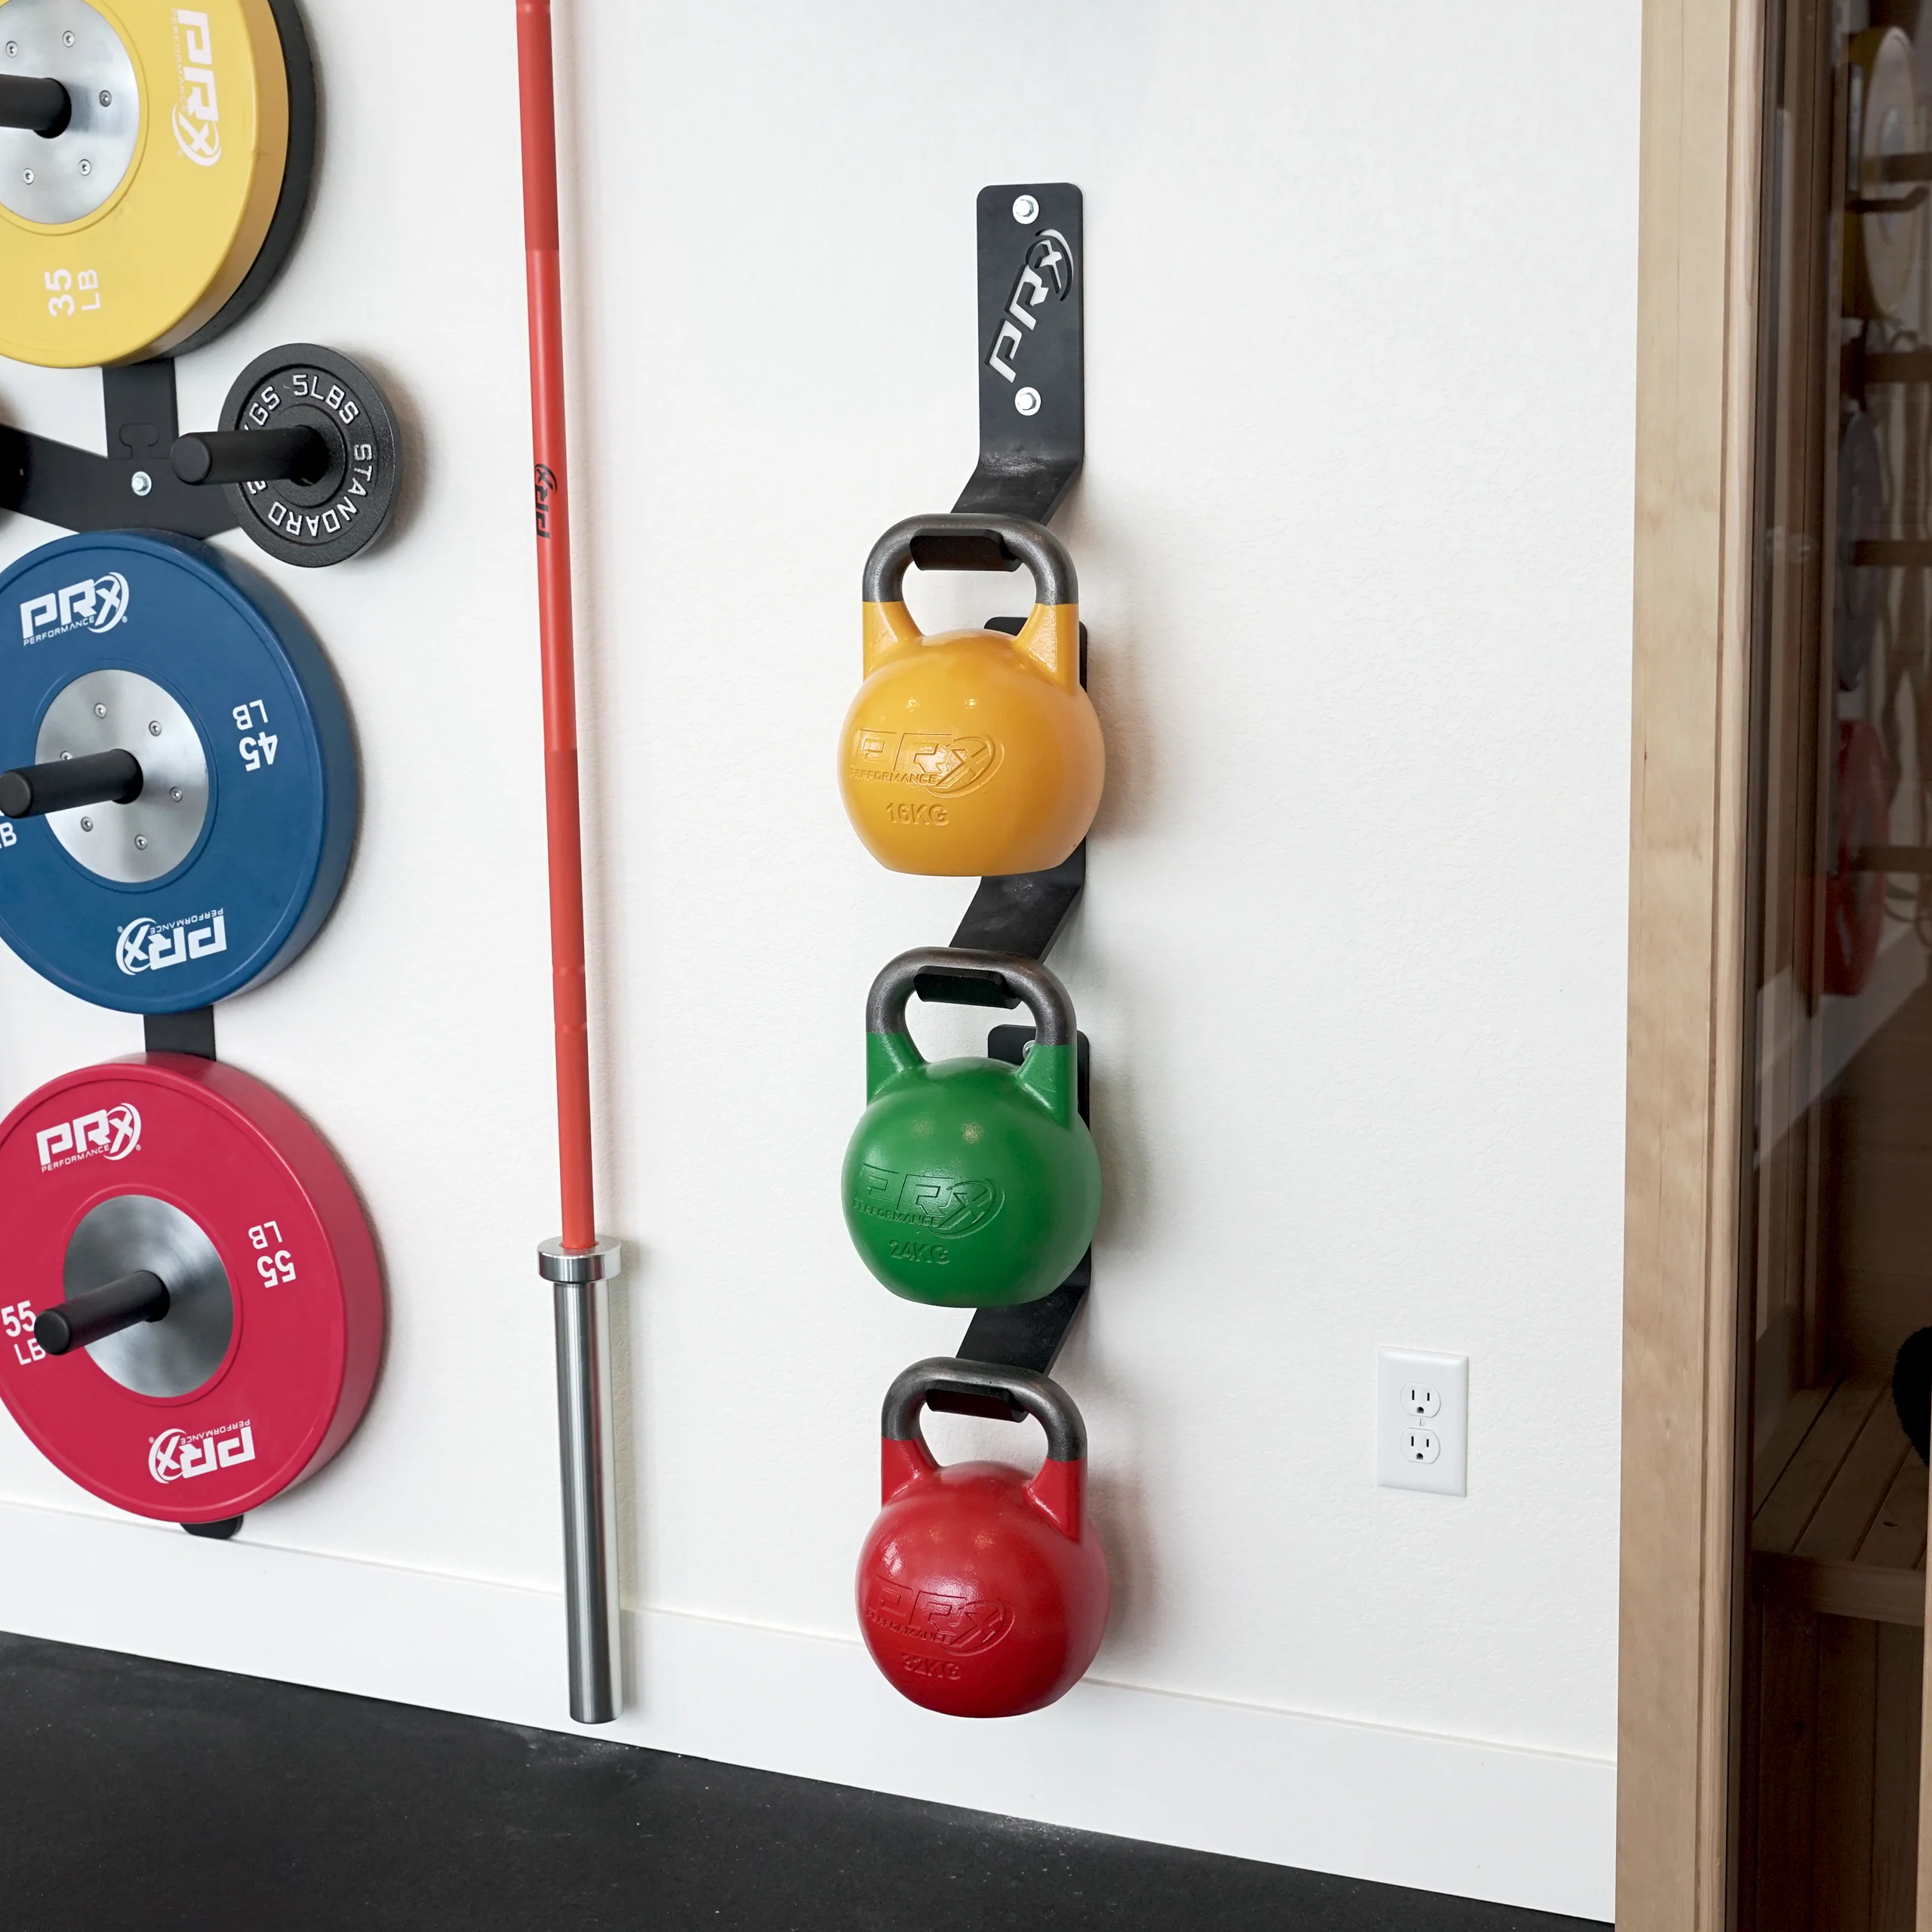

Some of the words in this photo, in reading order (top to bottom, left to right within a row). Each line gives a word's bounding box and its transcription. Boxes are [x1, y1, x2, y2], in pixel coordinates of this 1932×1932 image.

[171, 8, 187, 112] PERFORMANCE
[44, 268, 75, 318] 35
[77, 268, 101, 312] LB
[293, 374, 360, 424] 5LBS
[268, 444, 373, 537] STANDARD
[23, 615, 95, 647] PERFORMANCE
[232, 699, 269, 731] LB
[238, 731, 279, 772] 45
[886, 801, 949, 826] 16KG
[0, 822, 17, 849] B
[149, 908, 224, 935] PERFORMANCE
[41, 1143, 111, 1173] PERFORMANCE
[248, 1220, 283, 1250] LB
[889, 1238, 951, 1265] 24KG
[257, 1250, 297, 1288] 55
[1, 1300, 37, 1337] 55
[14, 1337, 46, 1365] LB
[180, 1418, 251, 1445] PERFORMANCE
